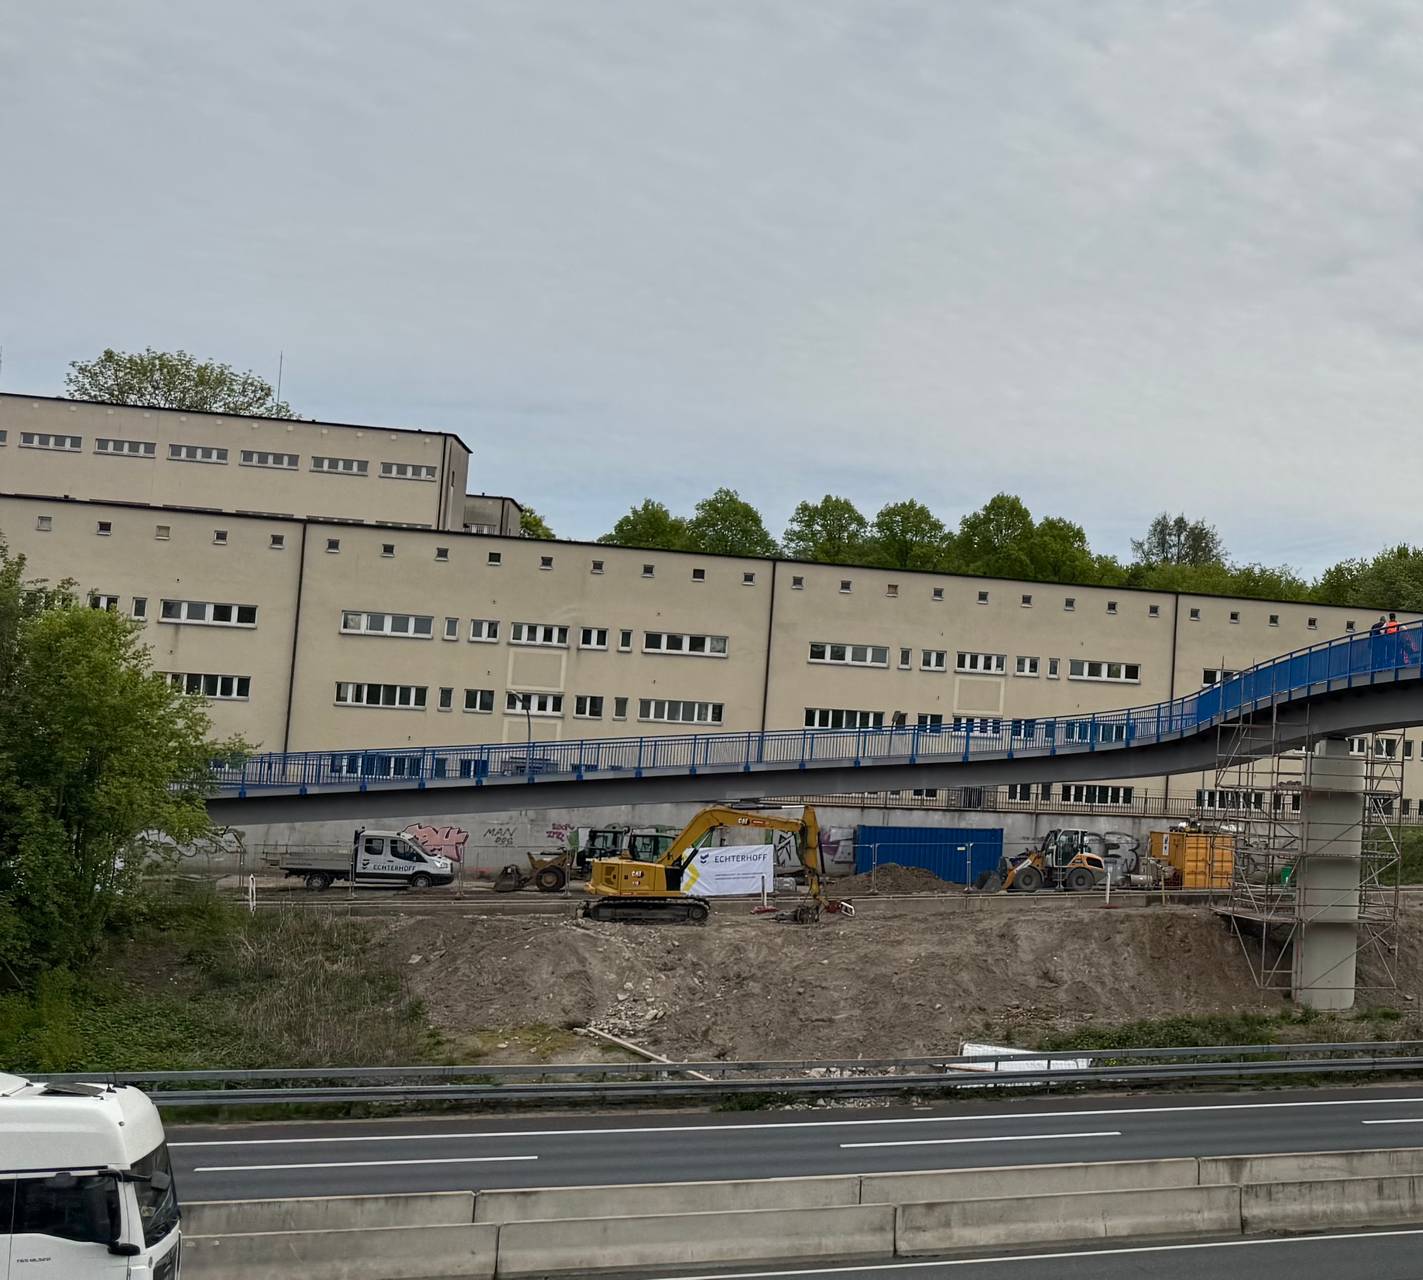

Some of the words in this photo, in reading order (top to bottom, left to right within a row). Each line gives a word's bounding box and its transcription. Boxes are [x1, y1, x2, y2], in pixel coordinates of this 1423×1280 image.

[483, 827, 518, 838] MAN
[714, 853, 768, 864] ECHTERHOFF
[373, 864, 417, 872] ECHTERHOFF
